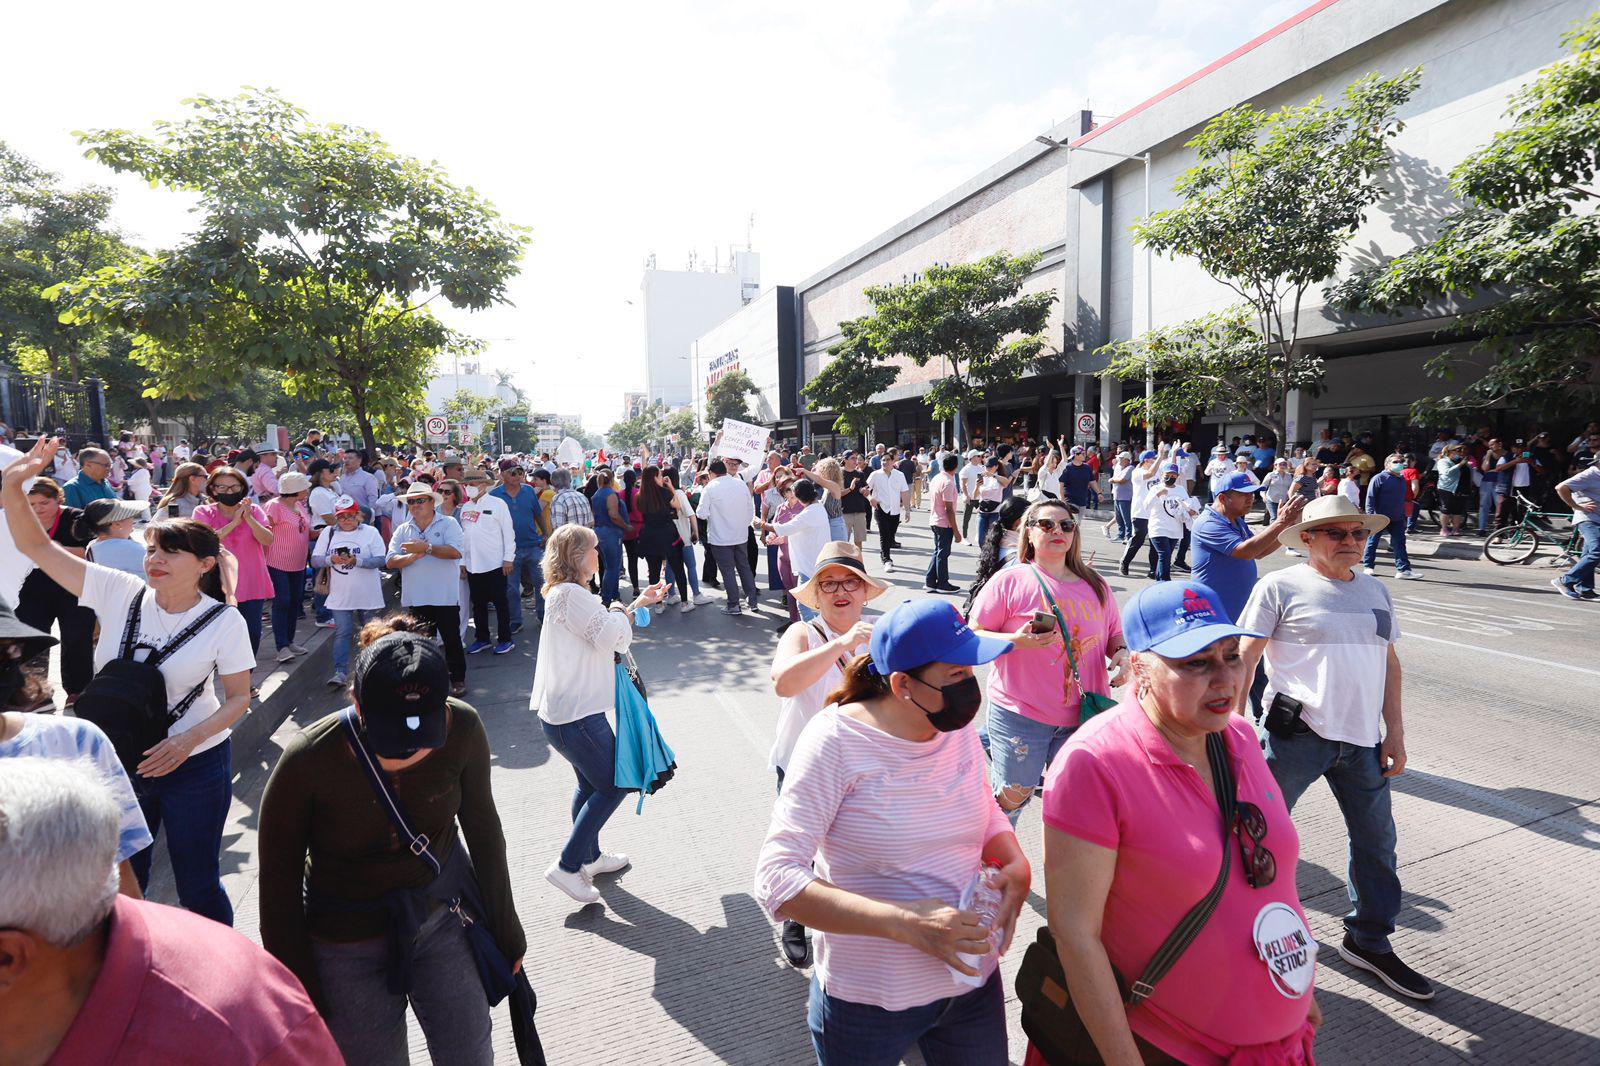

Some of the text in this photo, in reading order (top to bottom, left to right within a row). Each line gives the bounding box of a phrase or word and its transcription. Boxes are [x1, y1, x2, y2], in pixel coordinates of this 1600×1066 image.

[431, 421, 442, 429] 30
[1082, 418, 1093, 427] 30
[746, 439, 760, 450] INE
[1174, 617, 1186, 626] NO
